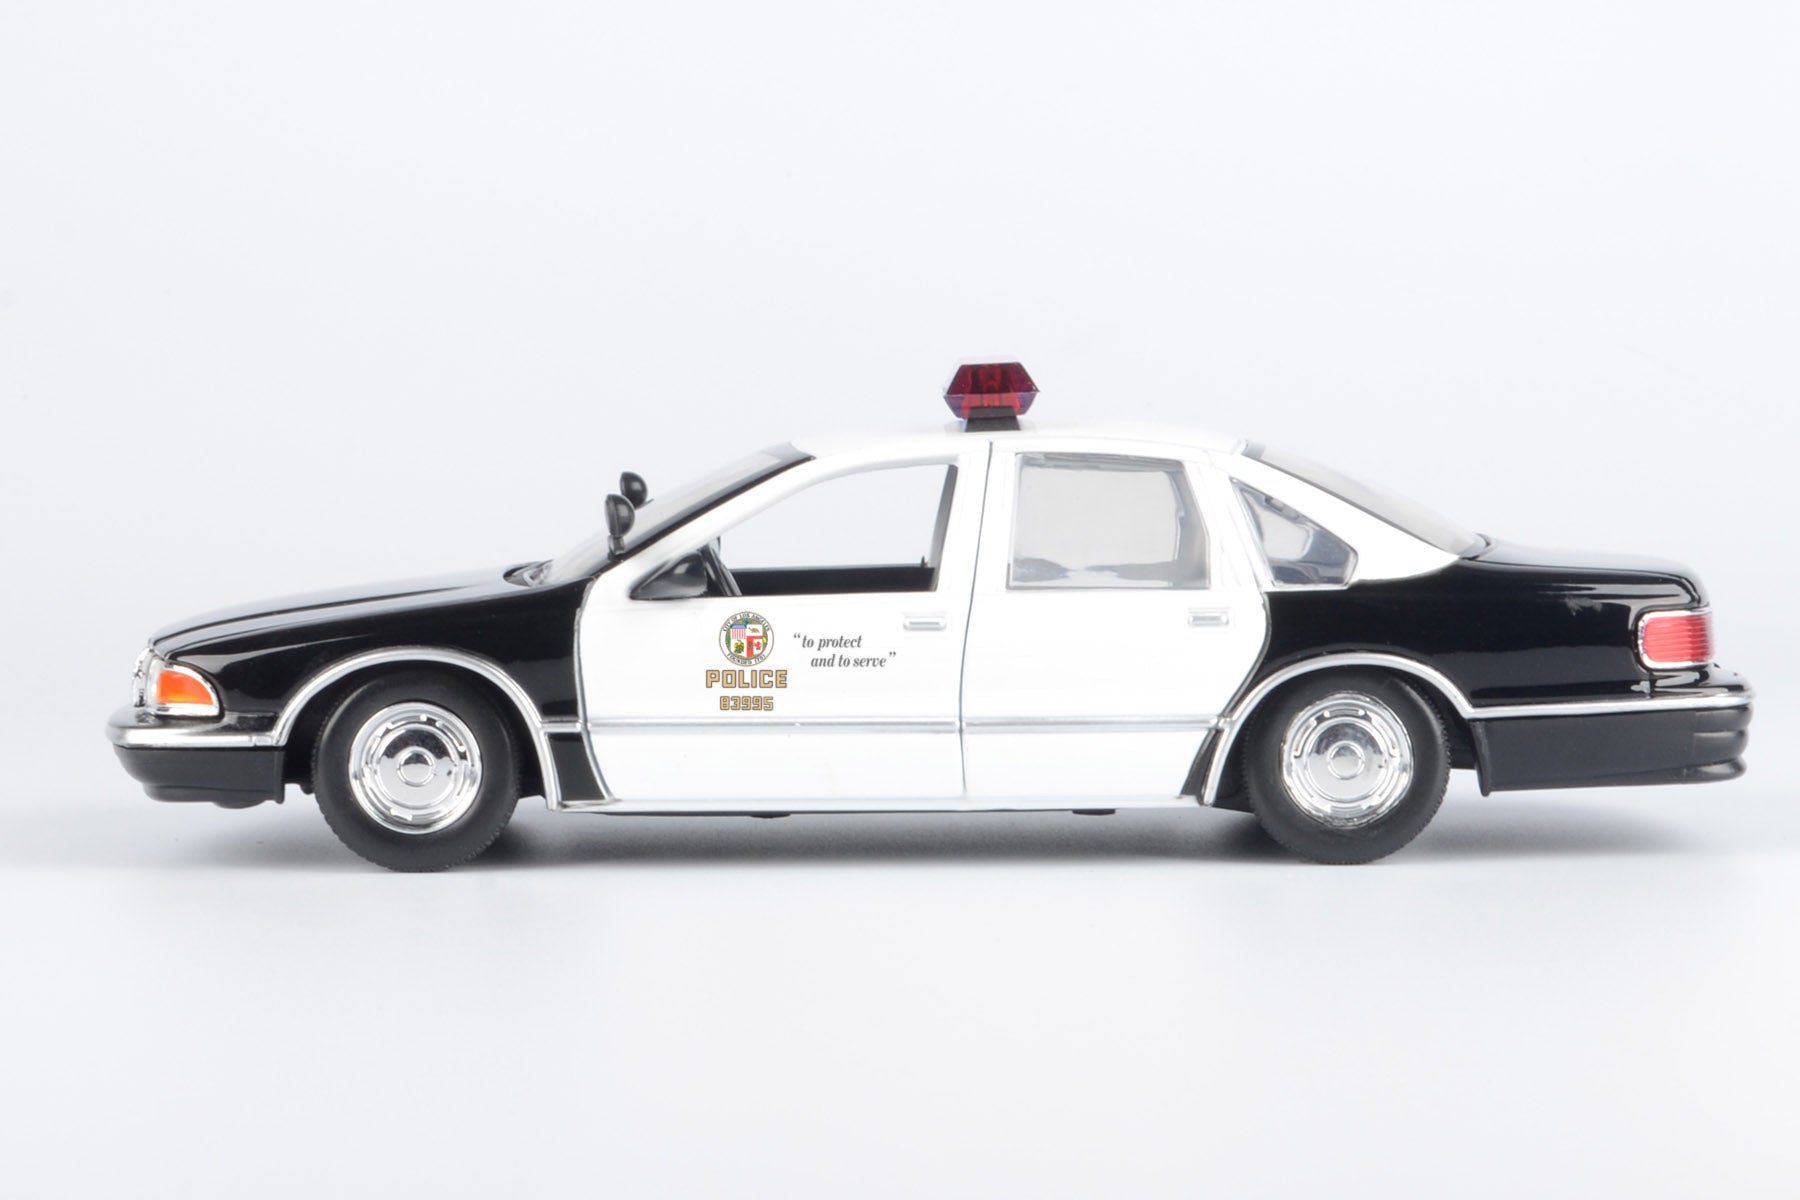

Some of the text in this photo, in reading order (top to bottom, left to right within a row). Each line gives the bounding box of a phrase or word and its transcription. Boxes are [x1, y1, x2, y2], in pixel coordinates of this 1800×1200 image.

[817, 635, 862, 651] protect
[810, 654, 835, 667] and
[838, 654, 850, 667] to
[705, 669, 788, 689] POLICE
[719, 696, 774, 711] 83995
